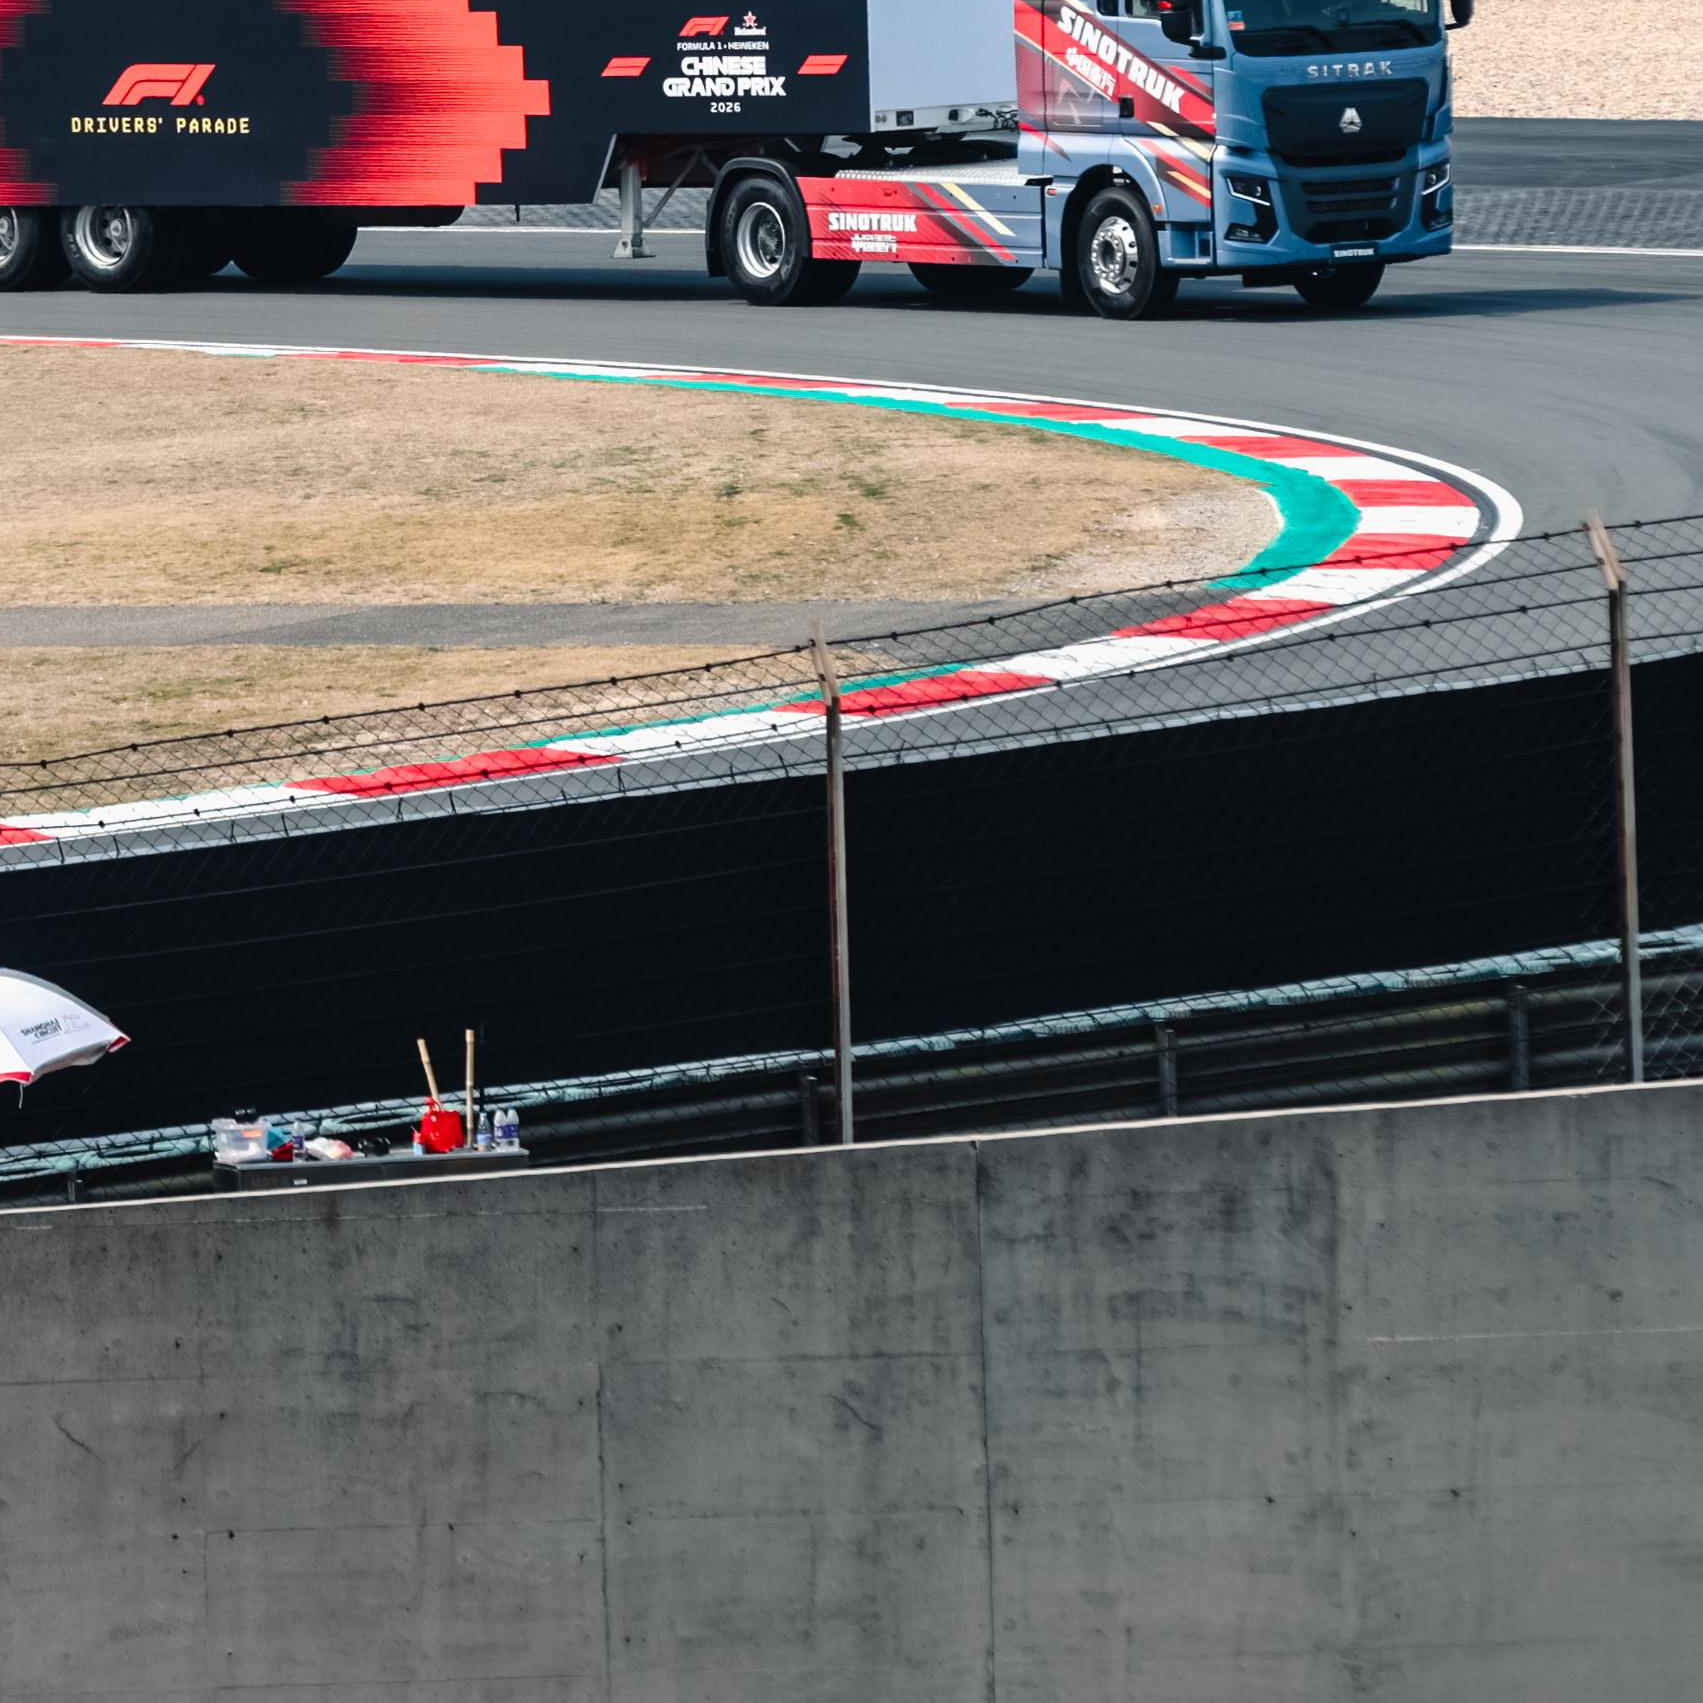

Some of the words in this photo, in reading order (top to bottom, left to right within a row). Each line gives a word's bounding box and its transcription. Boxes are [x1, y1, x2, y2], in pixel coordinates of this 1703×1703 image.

[677, 42, 715, 51] FORMULA
[728, 41, 769, 50] HEINEKEN
[681, 56, 766, 75] CHINESE
[1057, 6, 1185, 114] SINOTRUK
[1306, 60, 1393, 78] SITRAK
[663, 77, 736, 97] GRAND
[737, 76, 787, 96] PRIX
[710, 102, 741, 113] 2026
[176, 117, 251, 134] PARADE
[828, 212, 918, 232] SINOTRUK
[1334, 247, 1375, 258] SINOTRUK
